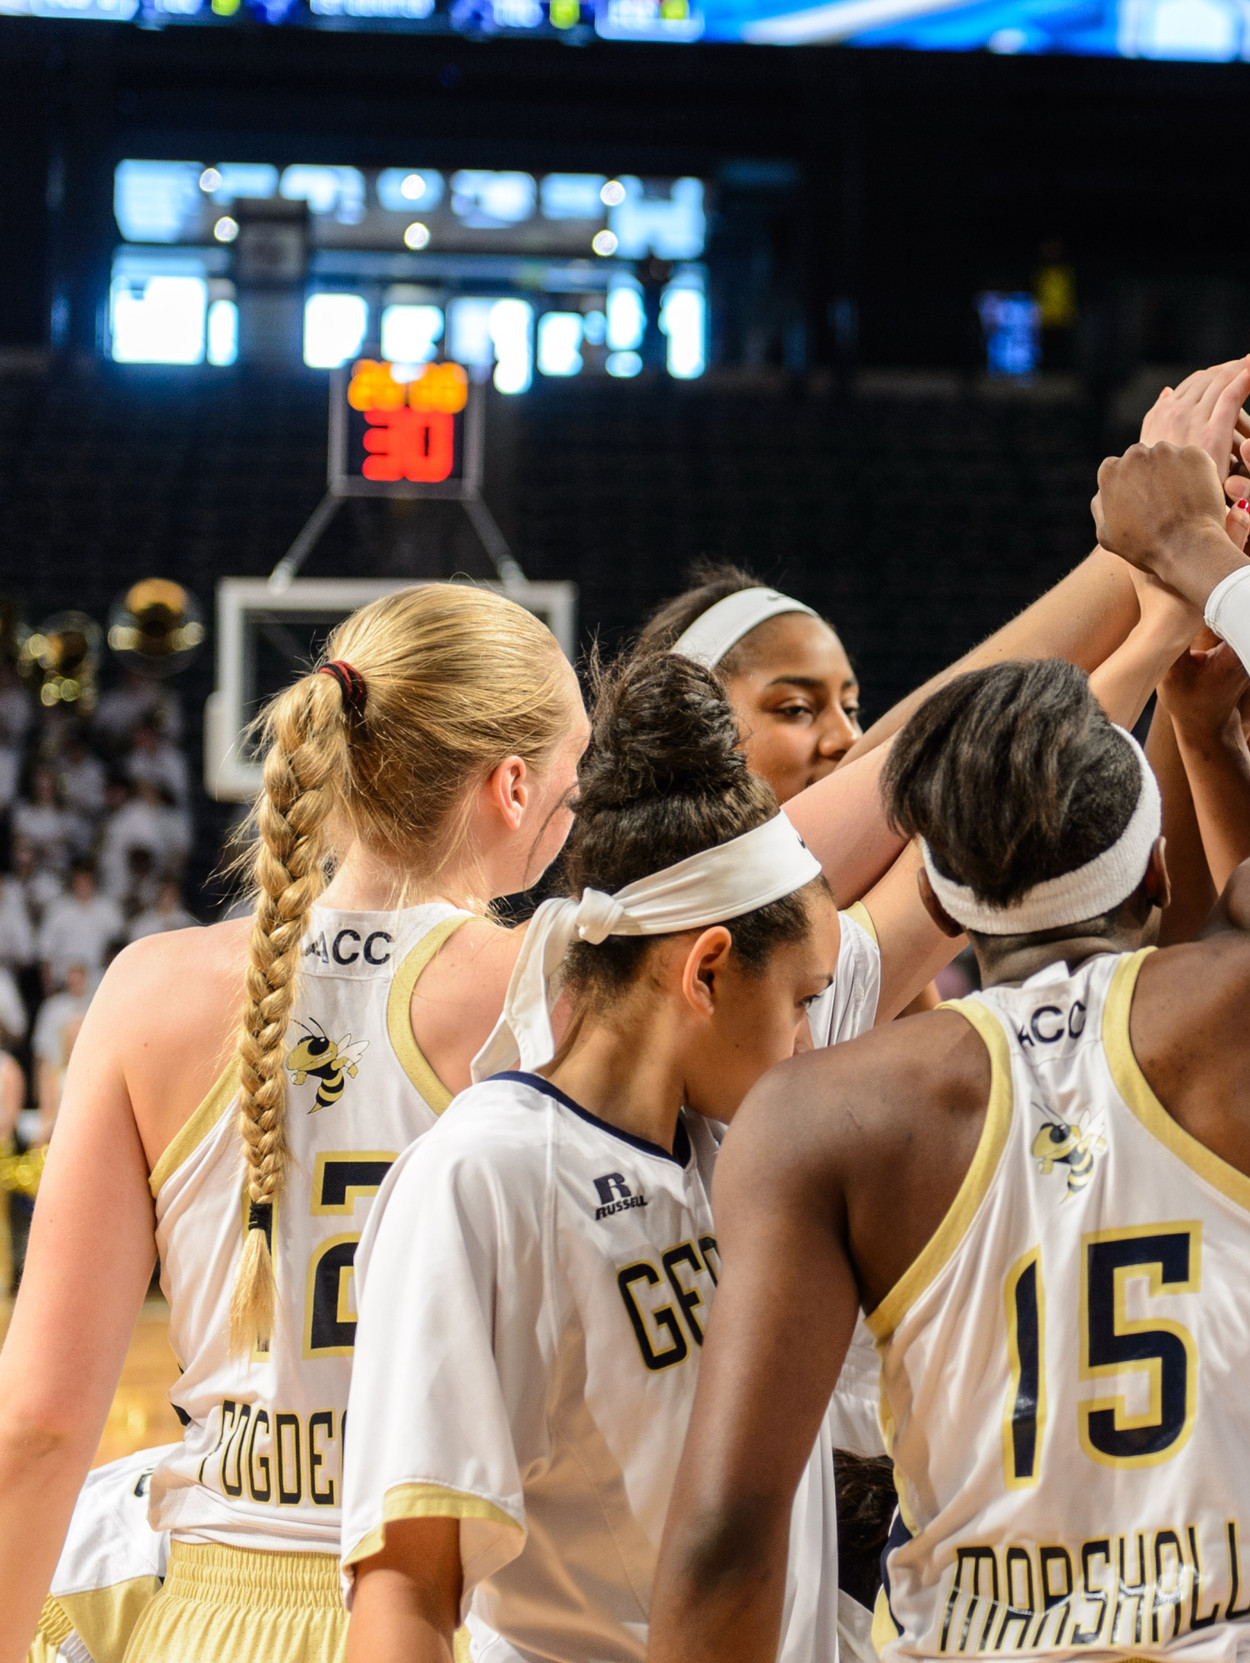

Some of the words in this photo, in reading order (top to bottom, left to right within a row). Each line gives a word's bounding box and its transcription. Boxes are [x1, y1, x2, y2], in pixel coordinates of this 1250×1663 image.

[362, 408, 454, 483] 30
[301, 929, 394, 966] ACC
[594, 1195, 648, 1221] RUSSELL
[1001, 1219, 1203, 1491] 15
[197, 1398, 348, 1507] FOGDE
